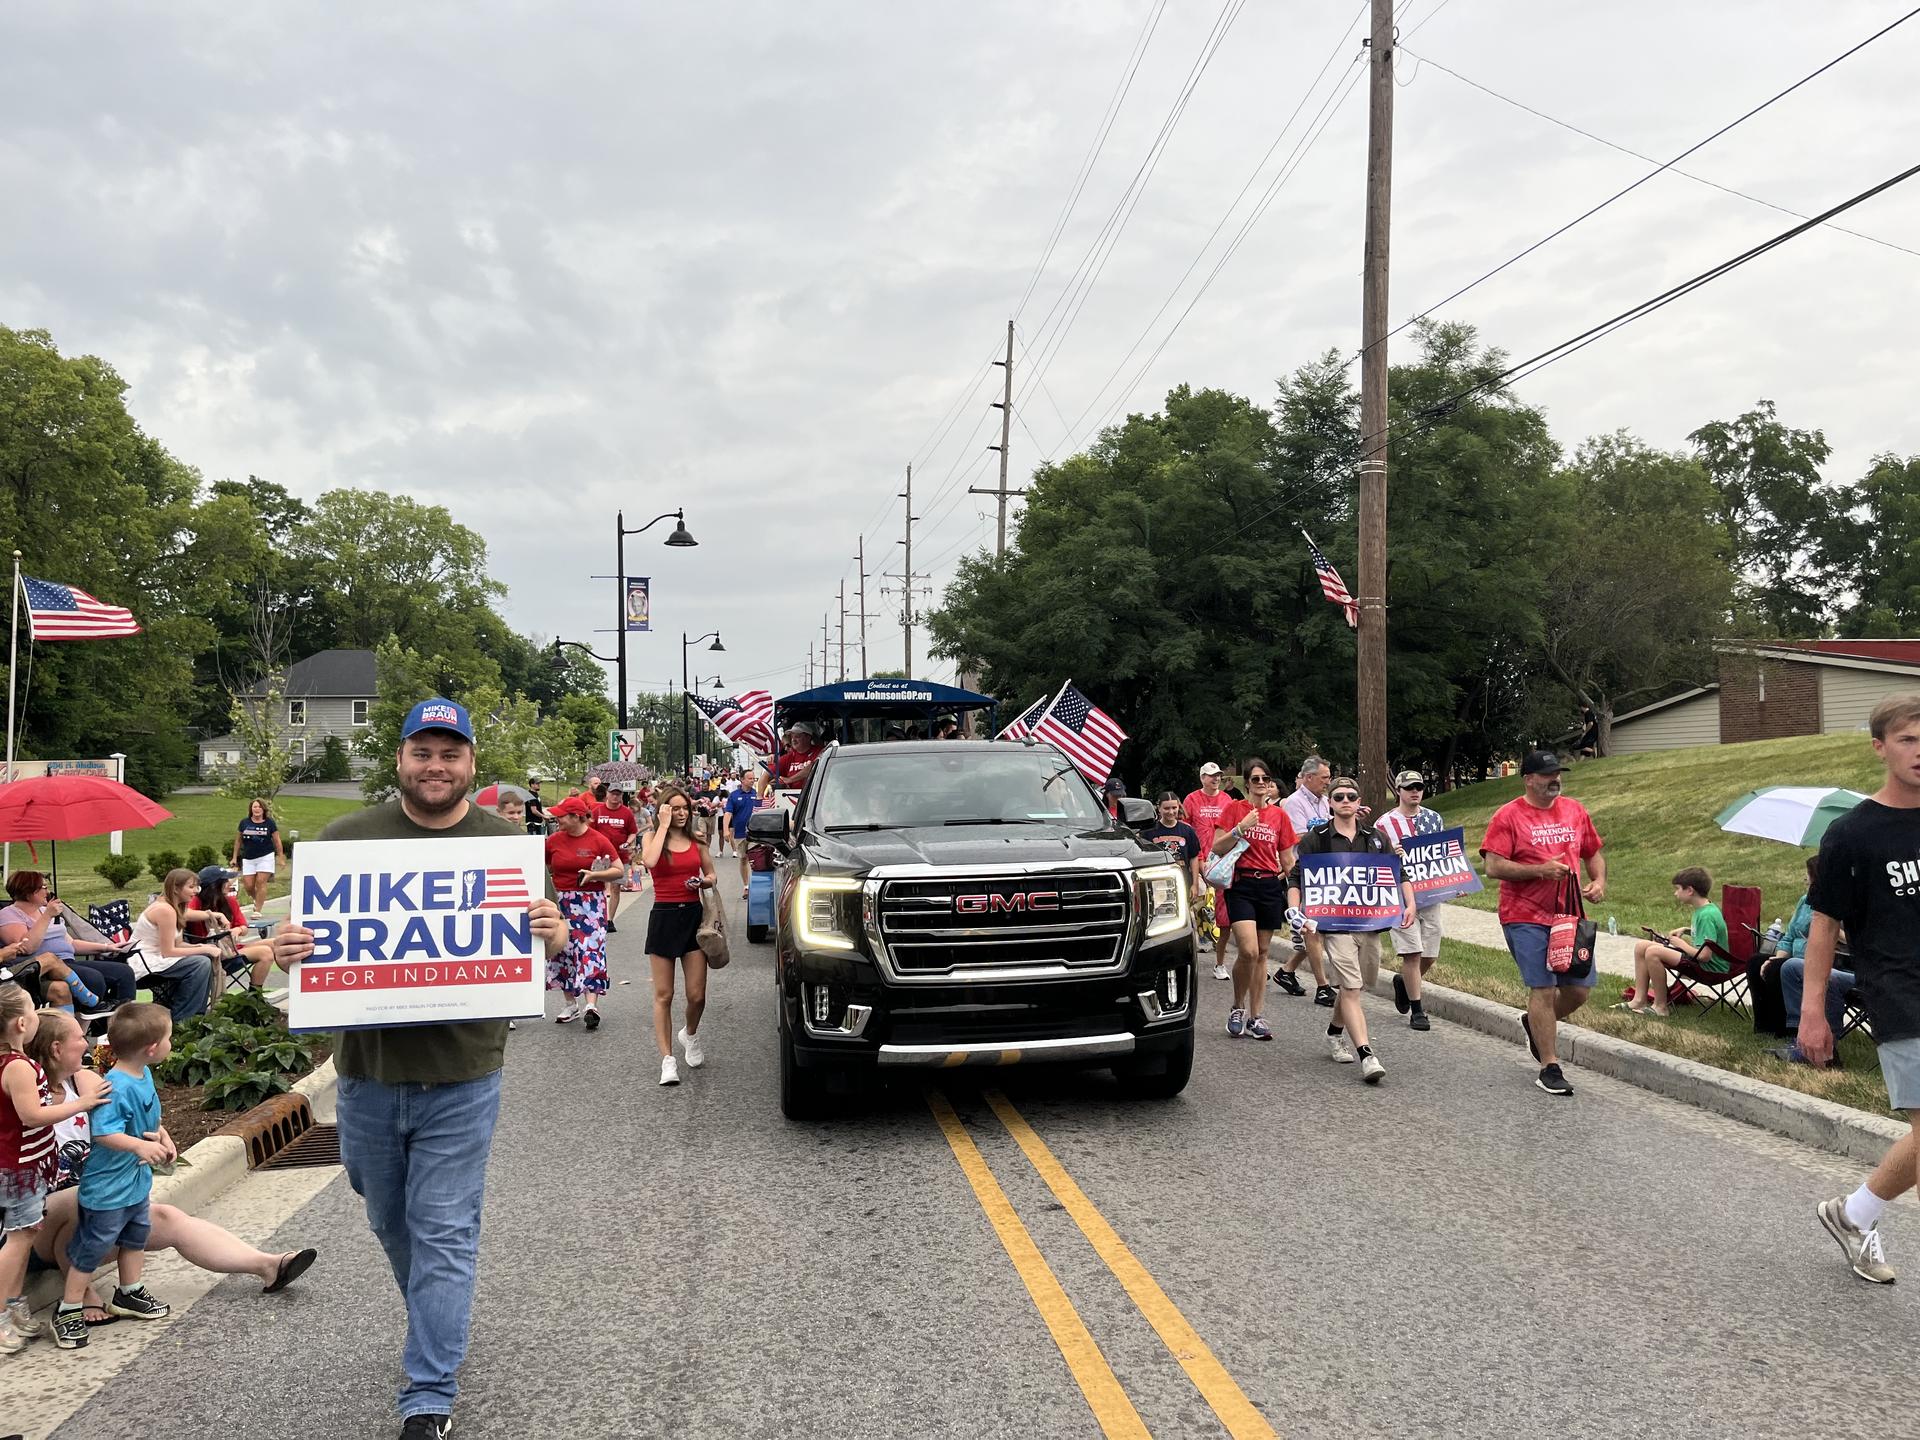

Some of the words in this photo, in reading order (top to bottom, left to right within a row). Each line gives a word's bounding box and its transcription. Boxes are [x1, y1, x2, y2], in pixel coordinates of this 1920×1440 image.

[867, 681, 891, 690] Contact
[843, 690, 933, 701] www.JohnsonGOP.org
[421, 711, 457, 722] BRAUN
[423, 705, 447, 713] MIKE
[1246, 830, 1276, 843] JUDGE
[1541, 833, 1576, 845] JUDGE
[1402, 843, 1442, 866] MIKE
[1303, 866, 1367, 886] MIKE
[1403, 856, 1469, 882] BRAUN
[1886, 860, 1920, 888] SH
[1414, 882, 1427, 890] FOR
[1432, 875, 1464, 886] INDIANA
[1895, 886, 1920, 896] CO
[302, 871, 456, 915] MIKE
[1305, 885, 1400, 906] BRAUN
[956, 892, 1059, 913] GMC
[1343, 907, 1389, 916] INDIANA
[301, 913, 532, 964] BRAUN
[325, 970, 375, 987] FOR
[393, 964, 507, 984] INDIANA
